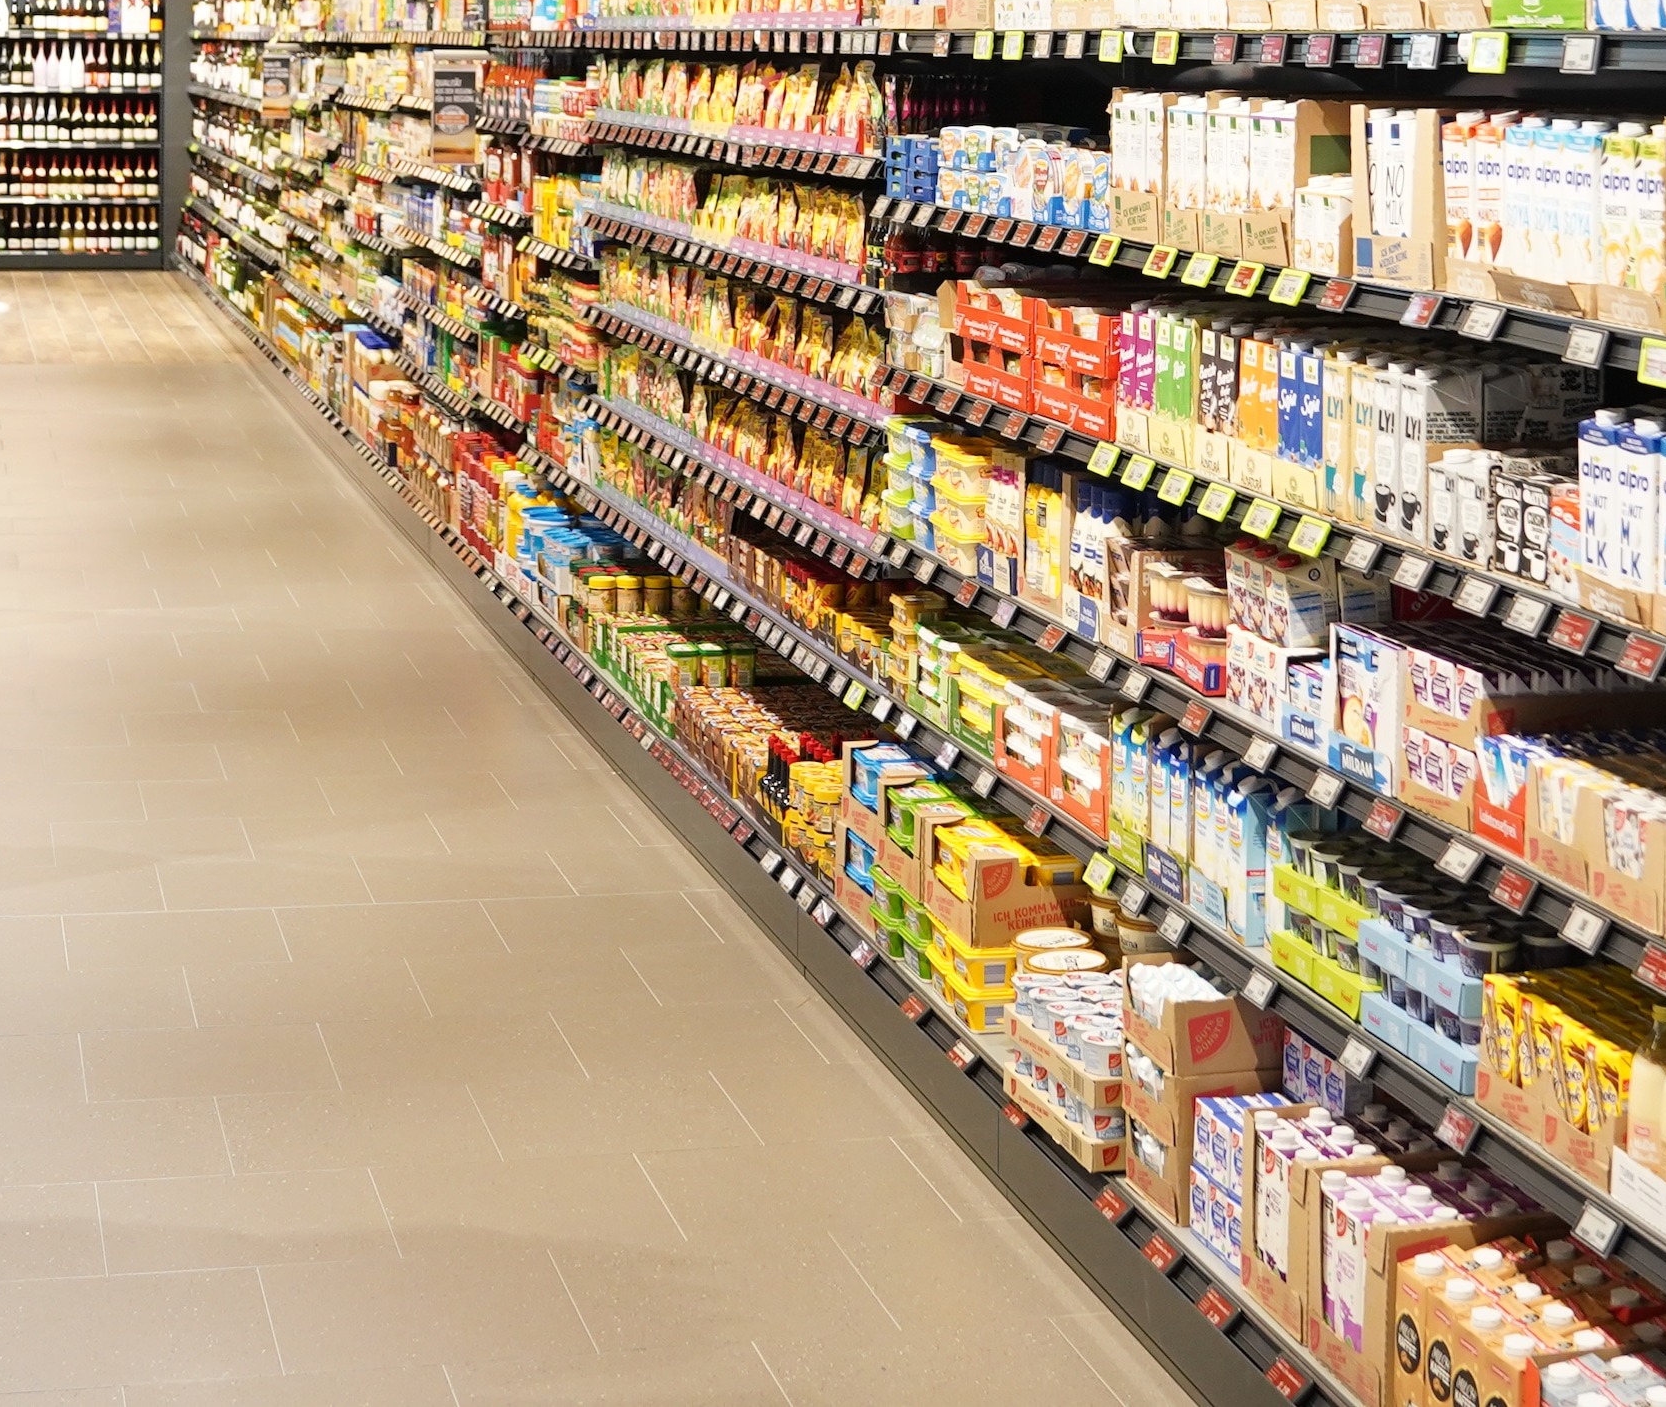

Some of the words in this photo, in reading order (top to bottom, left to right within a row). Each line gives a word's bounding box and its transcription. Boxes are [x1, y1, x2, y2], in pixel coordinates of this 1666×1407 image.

[1445, 154, 1468, 180] alpro
[1478, 156, 1501, 181] alpro
[1507, 159, 1531, 185] alpro
[1535, 162, 1561, 187] alpro
[1565, 164, 1592, 189] alpro
[1602, 167, 1630, 192] alpro
[1386, 164, 1405, 198] NO
[1385, 198, 1404, 226] MILK
[1278, 388, 1297, 412] Soja
[1301, 394, 1320, 418] Soja
[1327, 398, 1344, 420] LY!
[1356, 403, 1373, 425] LY!
[1378, 409, 1395, 434] LY!
[1405, 416, 1422, 440] LY!
[1582, 456, 1611, 484] alpro
[1618, 466, 1649, 494] alpro
[1594, 495, 1607, 508] NOT
[1628, 505, 1643, 519] NOT
[1291, 719, 1314, 738] MILRAM
[1341, 752, 1373, 780] MILRAM
[1479, 806, 1517, 839] Laktosefrei
[993, 912, 1011, 923] ICH
[1014, 905, 1048, 920] KOMM
[1008, 914, 1036, 930] KEINE
